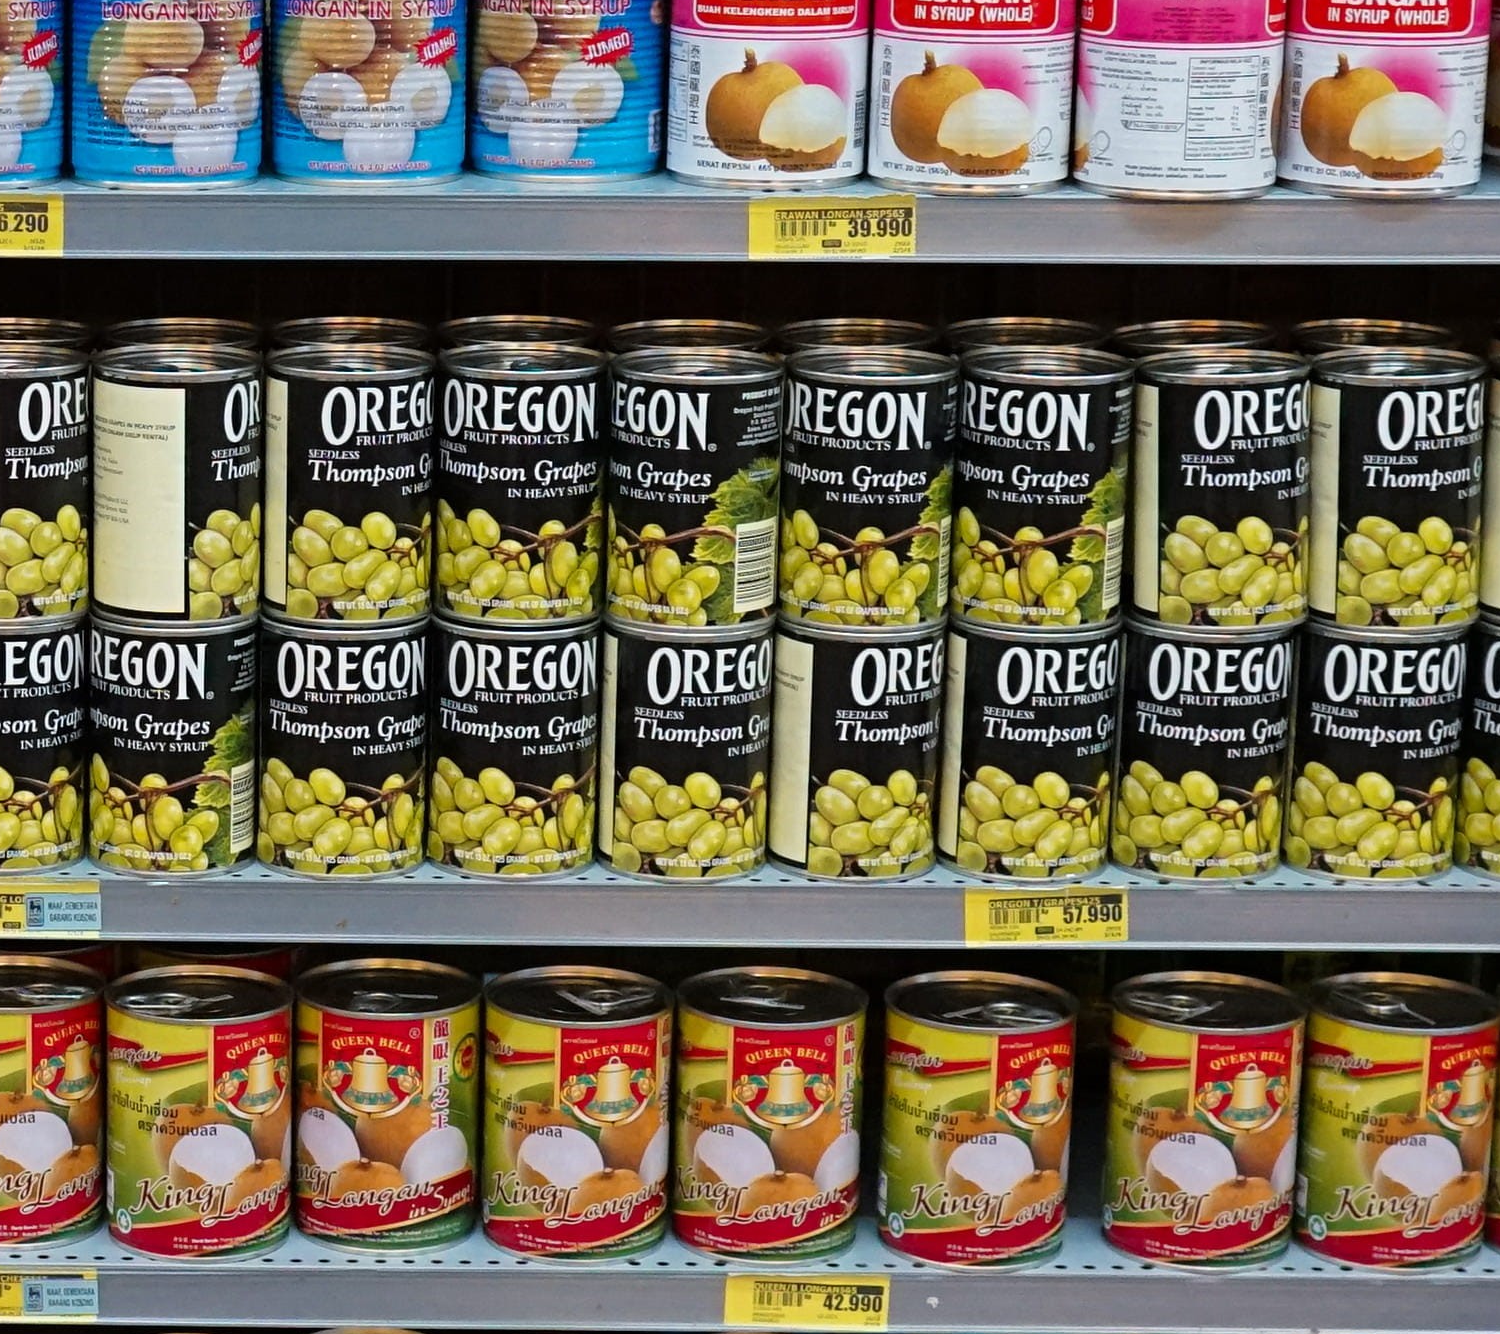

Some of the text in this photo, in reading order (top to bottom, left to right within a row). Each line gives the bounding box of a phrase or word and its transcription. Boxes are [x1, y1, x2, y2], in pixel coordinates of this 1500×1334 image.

[698, 5, 854, 17] BUAH KELENGKENG DALAM SIRUP
[914, 6, 1032, 24] IN SYRUP (WHOLE)
[584, 29, 629, 60] JUMBO
[850, 220, 912, 238] 39.990
[446, 386, 596, 434] OREGON
[464, 432, 569, 445] FRUIT PRODUCTS
[309, 449, 359, 460] SEEDLESS
[308, 458, 414, 488] Thompson
[113, 737, 207, 753] IN HEAVY SYRUP
[1062, 906, 1121, 924] 57.990
[332, 1035, 411, 1054] QUEEN BELL
[135, 1174, 218, 1213] King
[314, 1170, 433, 1211] Longan
[823, 1294, 882, 1313] 42.990
